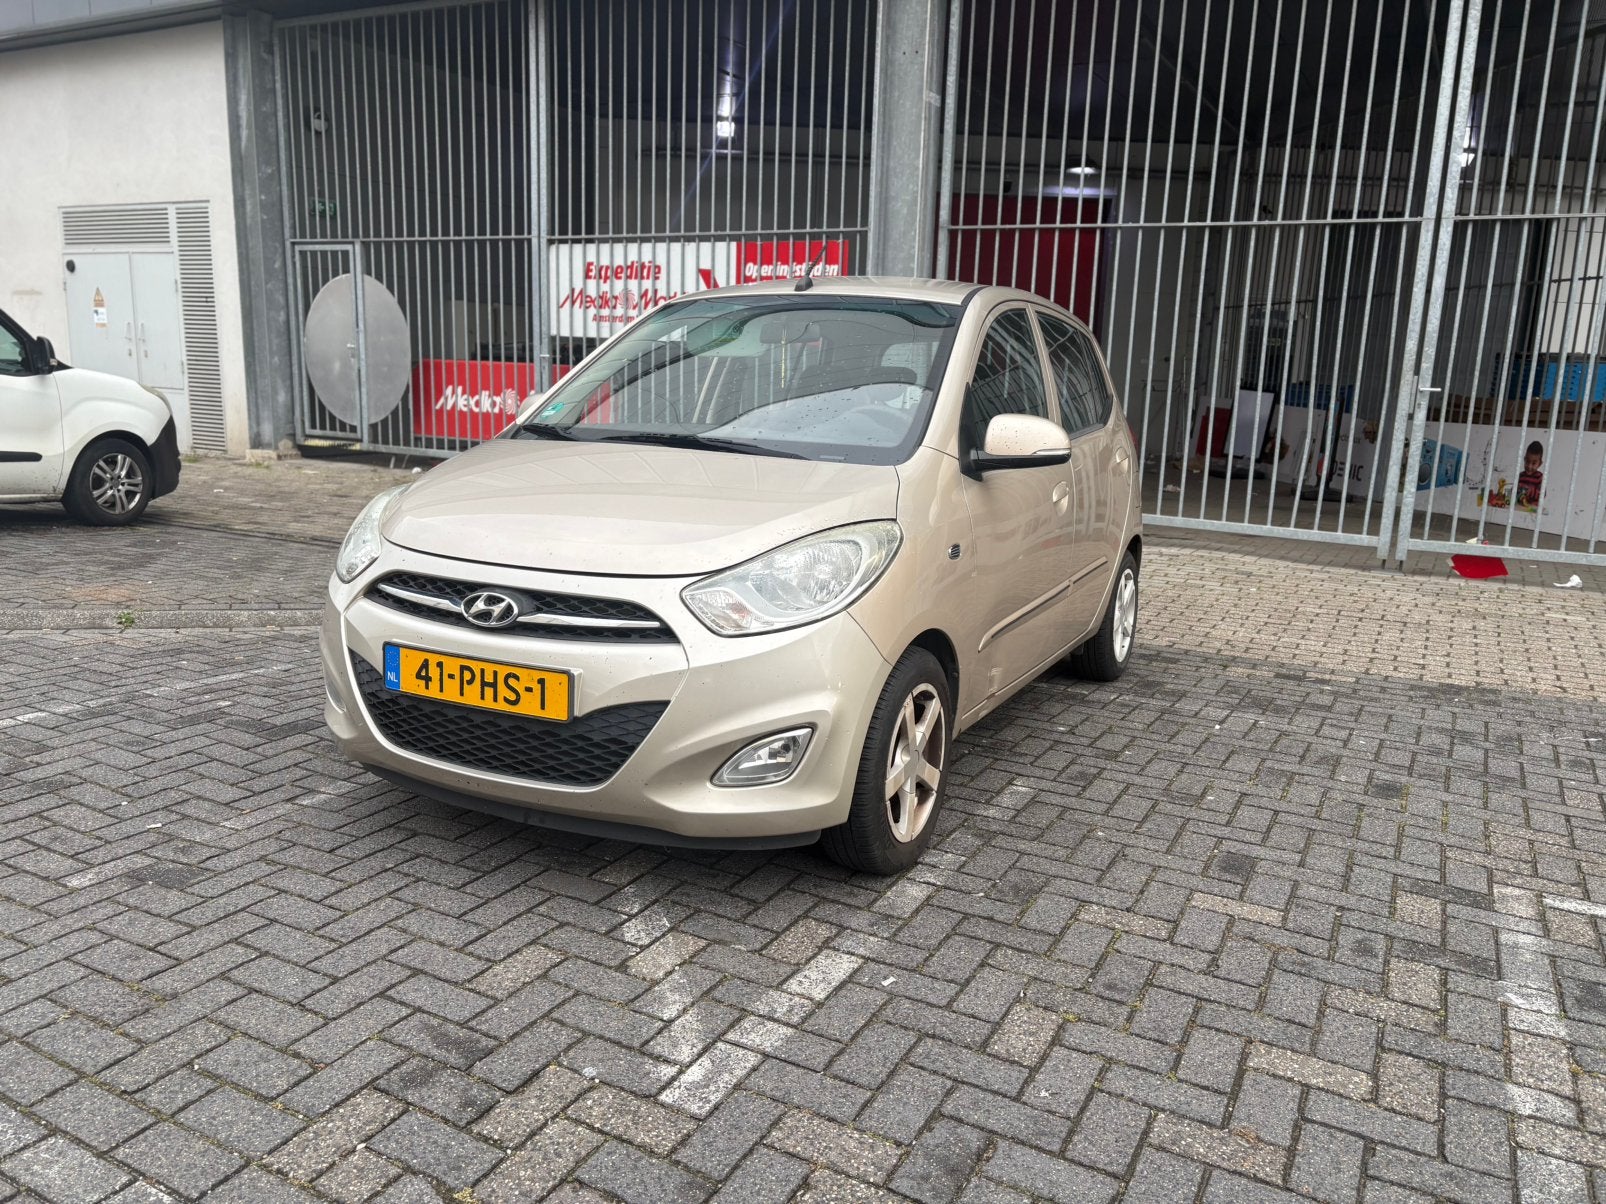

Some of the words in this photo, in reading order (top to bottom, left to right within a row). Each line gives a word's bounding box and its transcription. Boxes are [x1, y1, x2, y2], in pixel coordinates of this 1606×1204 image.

[585, 260, 662, 284] Expeditie
[745, 261, 839, 279] Openingstjden
[559, 287, 619, 310] Media
[592, 313, 635, 323] Amsterdm
[435, 385, 500, 414] Media
[387, 671, 398, 683] NL
[415, 658, 546, 711] 41-PHS-1
